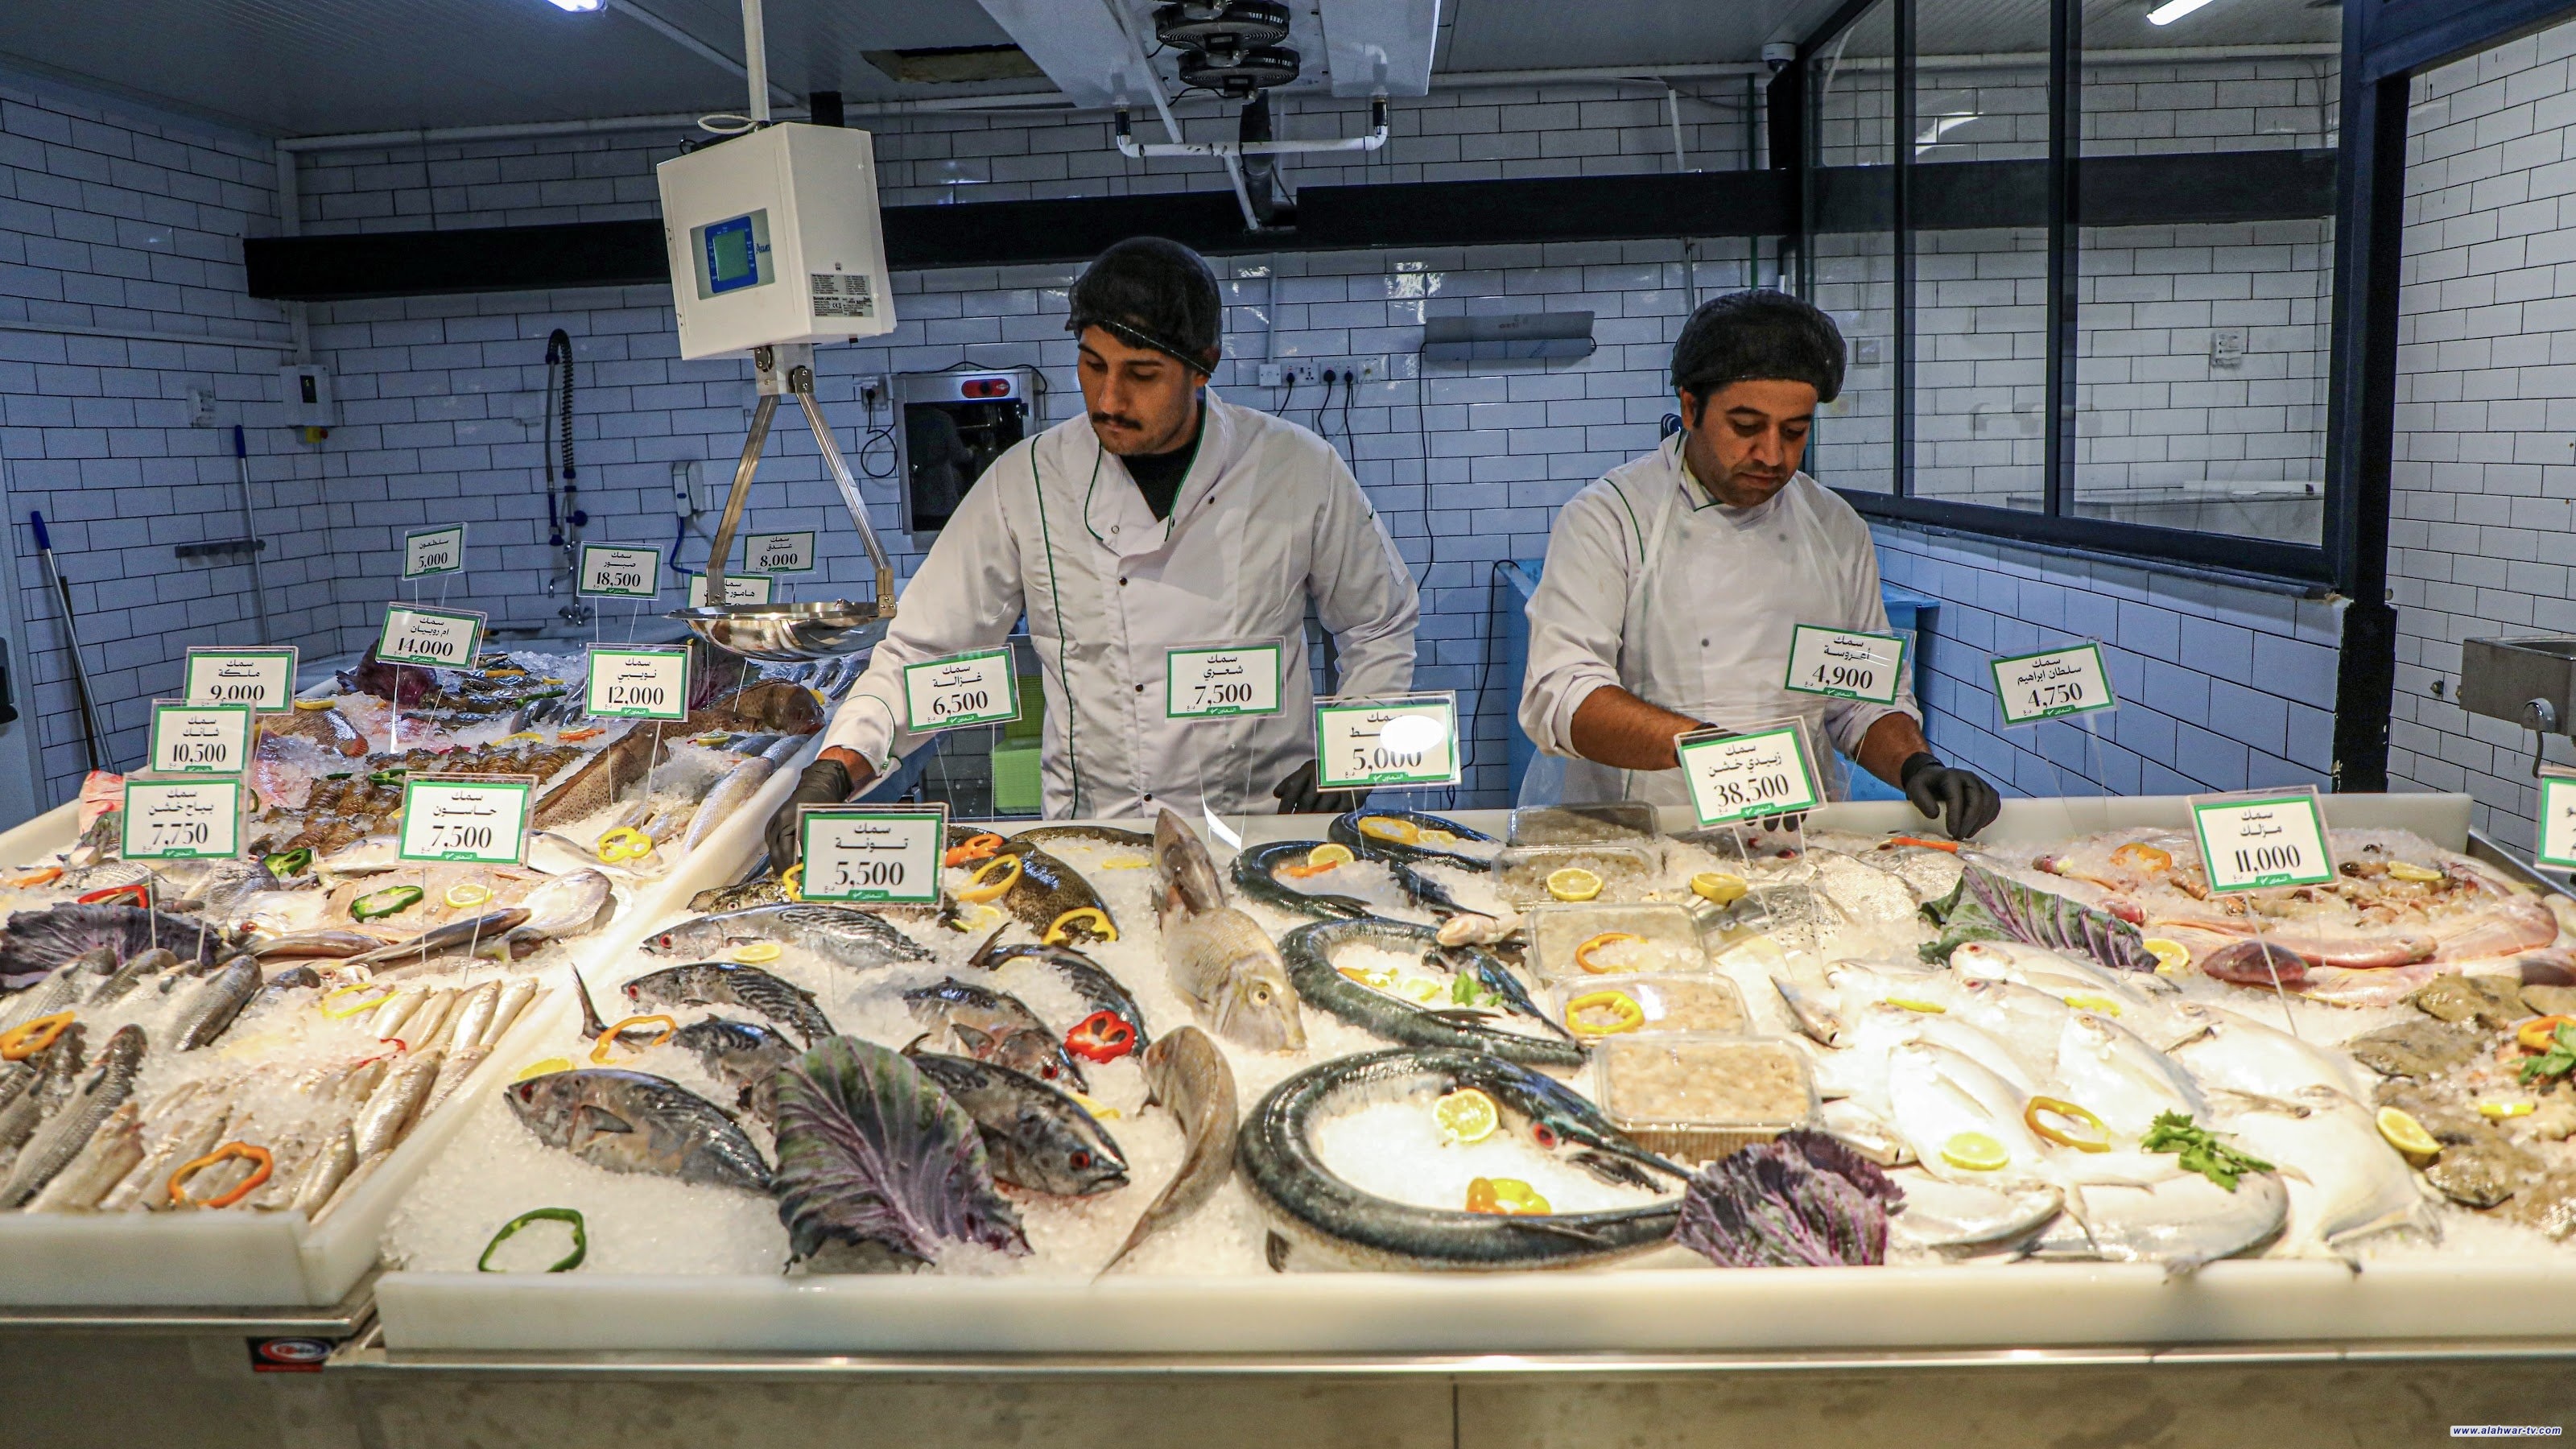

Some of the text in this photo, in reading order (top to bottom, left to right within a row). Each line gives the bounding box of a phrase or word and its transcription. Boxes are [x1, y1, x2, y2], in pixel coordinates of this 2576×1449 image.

[419, 539, 449, 549] سلطعون
[419, 551, 448, 568] 5,000
[760, 553, 798, 568] 8,000
[597, 572, 641, 587] 18,500
[419, 617, 445, 625] سمك
[410, 625, 449, 638] ام روبيان
[398, 638, 453, 657] 14,000
[1833, 635, 1864, 647] سمك
[226, 659, 254, 667] سمك
[625, 658, 650, 667] سمك
[1208, 654, 1237, 663] سمك
[2032, 658, 2061, 668] سمك
[218, 669, 260, 677] ملكة
[617, 669, 657, 683] نويبي
[942, 665, 971, 675] سمك
[1203, 665, 1243, 681] شعري
[1812, 664, 1872, 689] 4,900
[2017, 665, 2082, 685] سلطان ابراهيم
[932, 672, 982, 687] غزالة
[210, 685, 265, 702] 9,000
[608, 686, 664, 706] 12,000
[1195, 683, 1252, 707] 7,500
[2028, 683, 2083, 708] 4,750
[933, 690, 989, 716] 6,500
[188, 715, 217, 724] سمك
[183, 727, 220, 737] شانك
[173, 743, 226, 765] 10,500
[1725, 744, 1757, 756] سمك
[1352, 747, 1422, 773] 5,000
[1707, 752, 1781, 778] زبيدي خشن
[167, 788, 197, 798] سمك
[451, 791, 483, 801] سمك
[1714, 774, 1789, 807] 38,500
[148, 801, 214, 816] بياح خشن
[433, 805, 497, 817] حاسون
[2241, 809, 2273, 821] سمك
[152, 822, 208, 848] 7,750
[854, 823, 891, 834] سمك
[431, 825, 492, 850] 7,500
[836, 837, 909, 852] تونة
[2235, 844, 2301, 876] 11,000
[835, 861, 904, 889] 5,500
